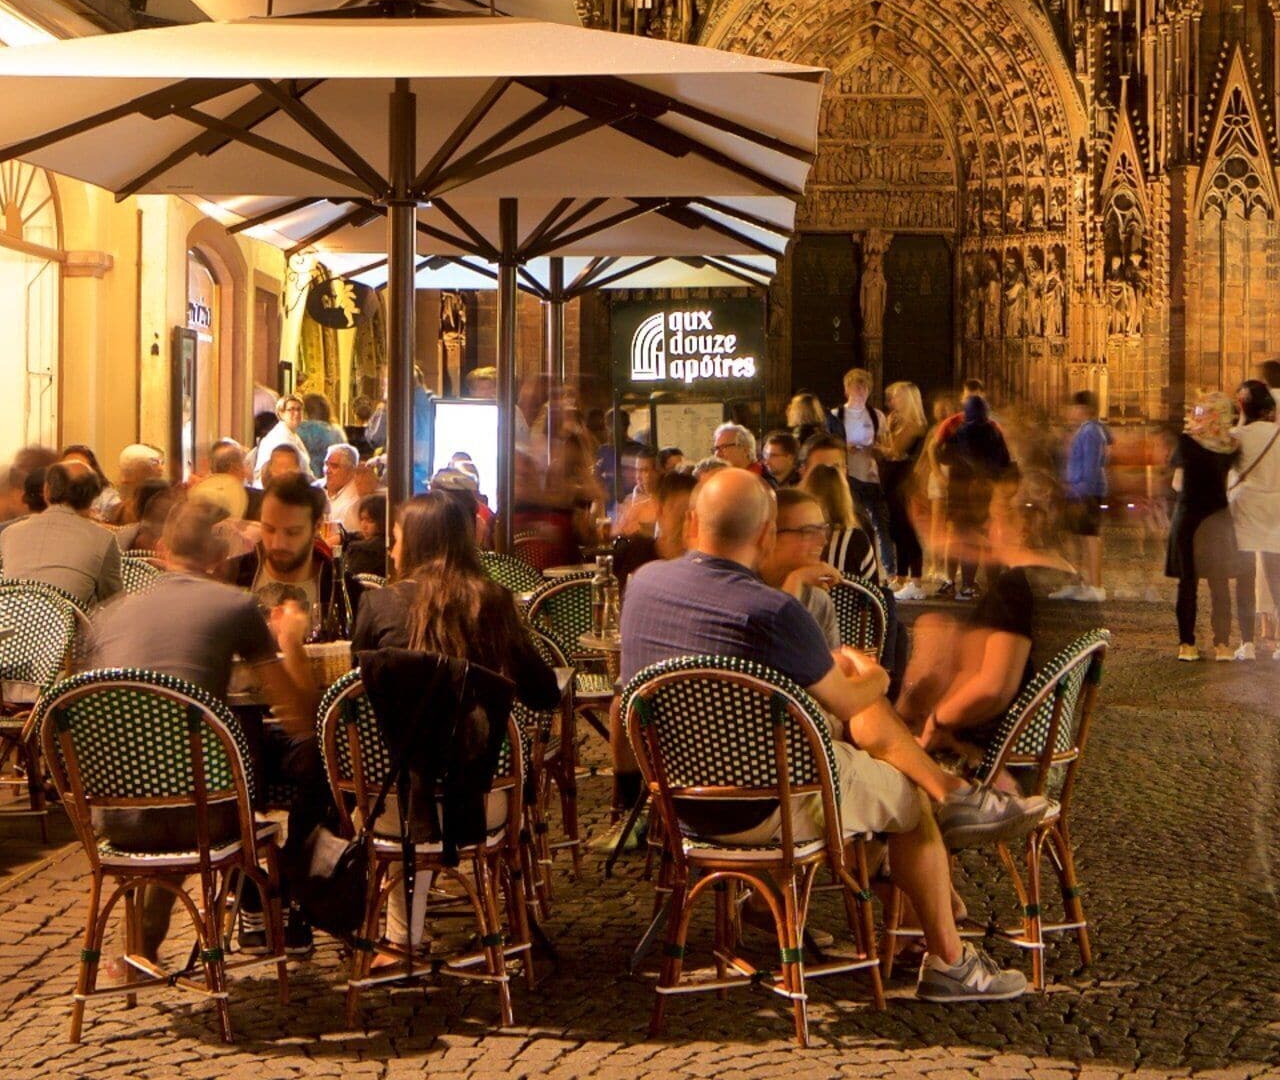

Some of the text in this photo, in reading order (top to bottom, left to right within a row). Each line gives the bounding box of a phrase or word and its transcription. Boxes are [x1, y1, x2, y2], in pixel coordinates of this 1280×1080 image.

[668, 310, 713, 331] aux
[669, 331, 737, 354] douze
[669, 354, 756, 383] apôtres
